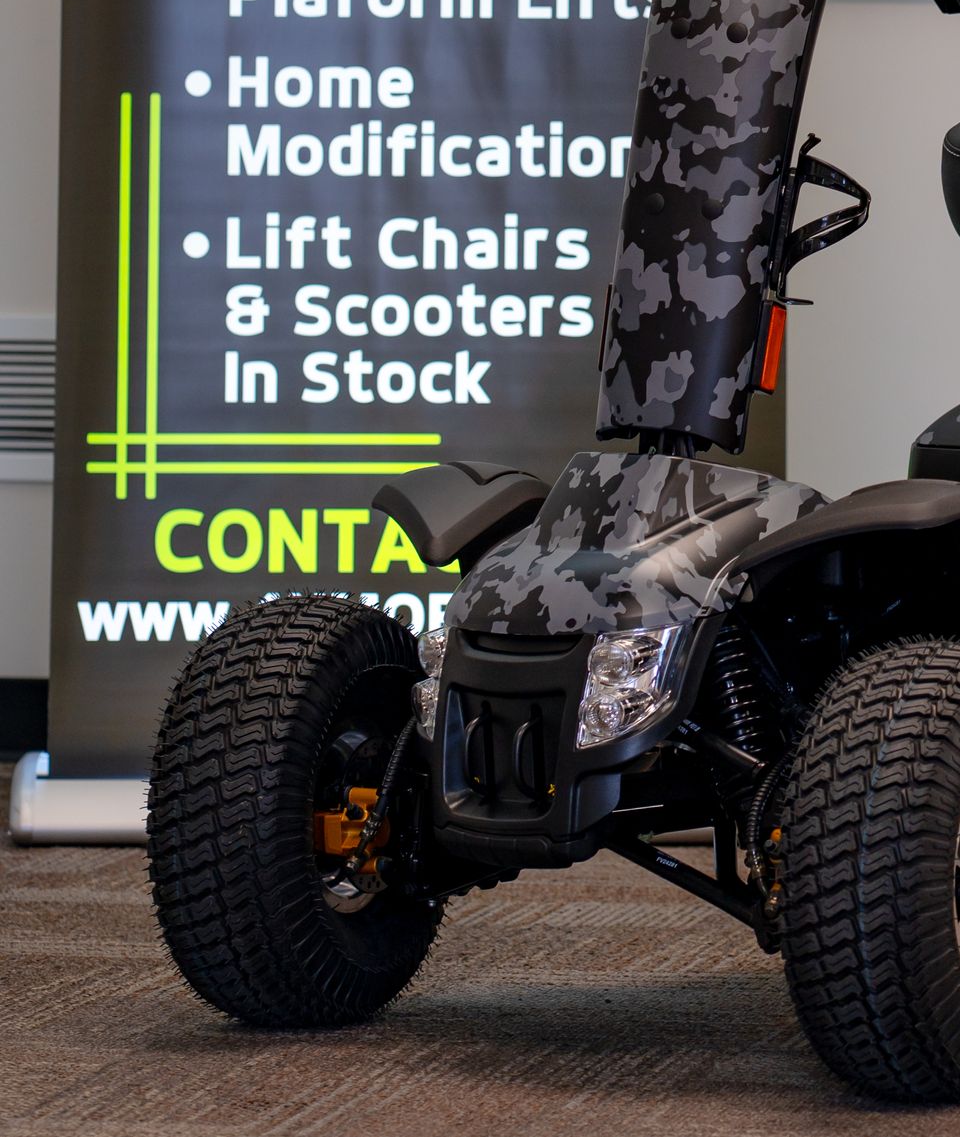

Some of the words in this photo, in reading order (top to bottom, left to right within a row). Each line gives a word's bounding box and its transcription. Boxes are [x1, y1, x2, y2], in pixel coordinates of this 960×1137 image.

[227, 55, 415, 109] Home
[225, 211, 354, 271] Lift
[376, 212, 592, 272] Chairs
[224, 283, 272, 338] &
[292, 282, 595, 339] Scooters
[224, 350, 280, 405] In
[300, 349, 493, 405] Stock
[154, 508, 461, 574] CONTA
